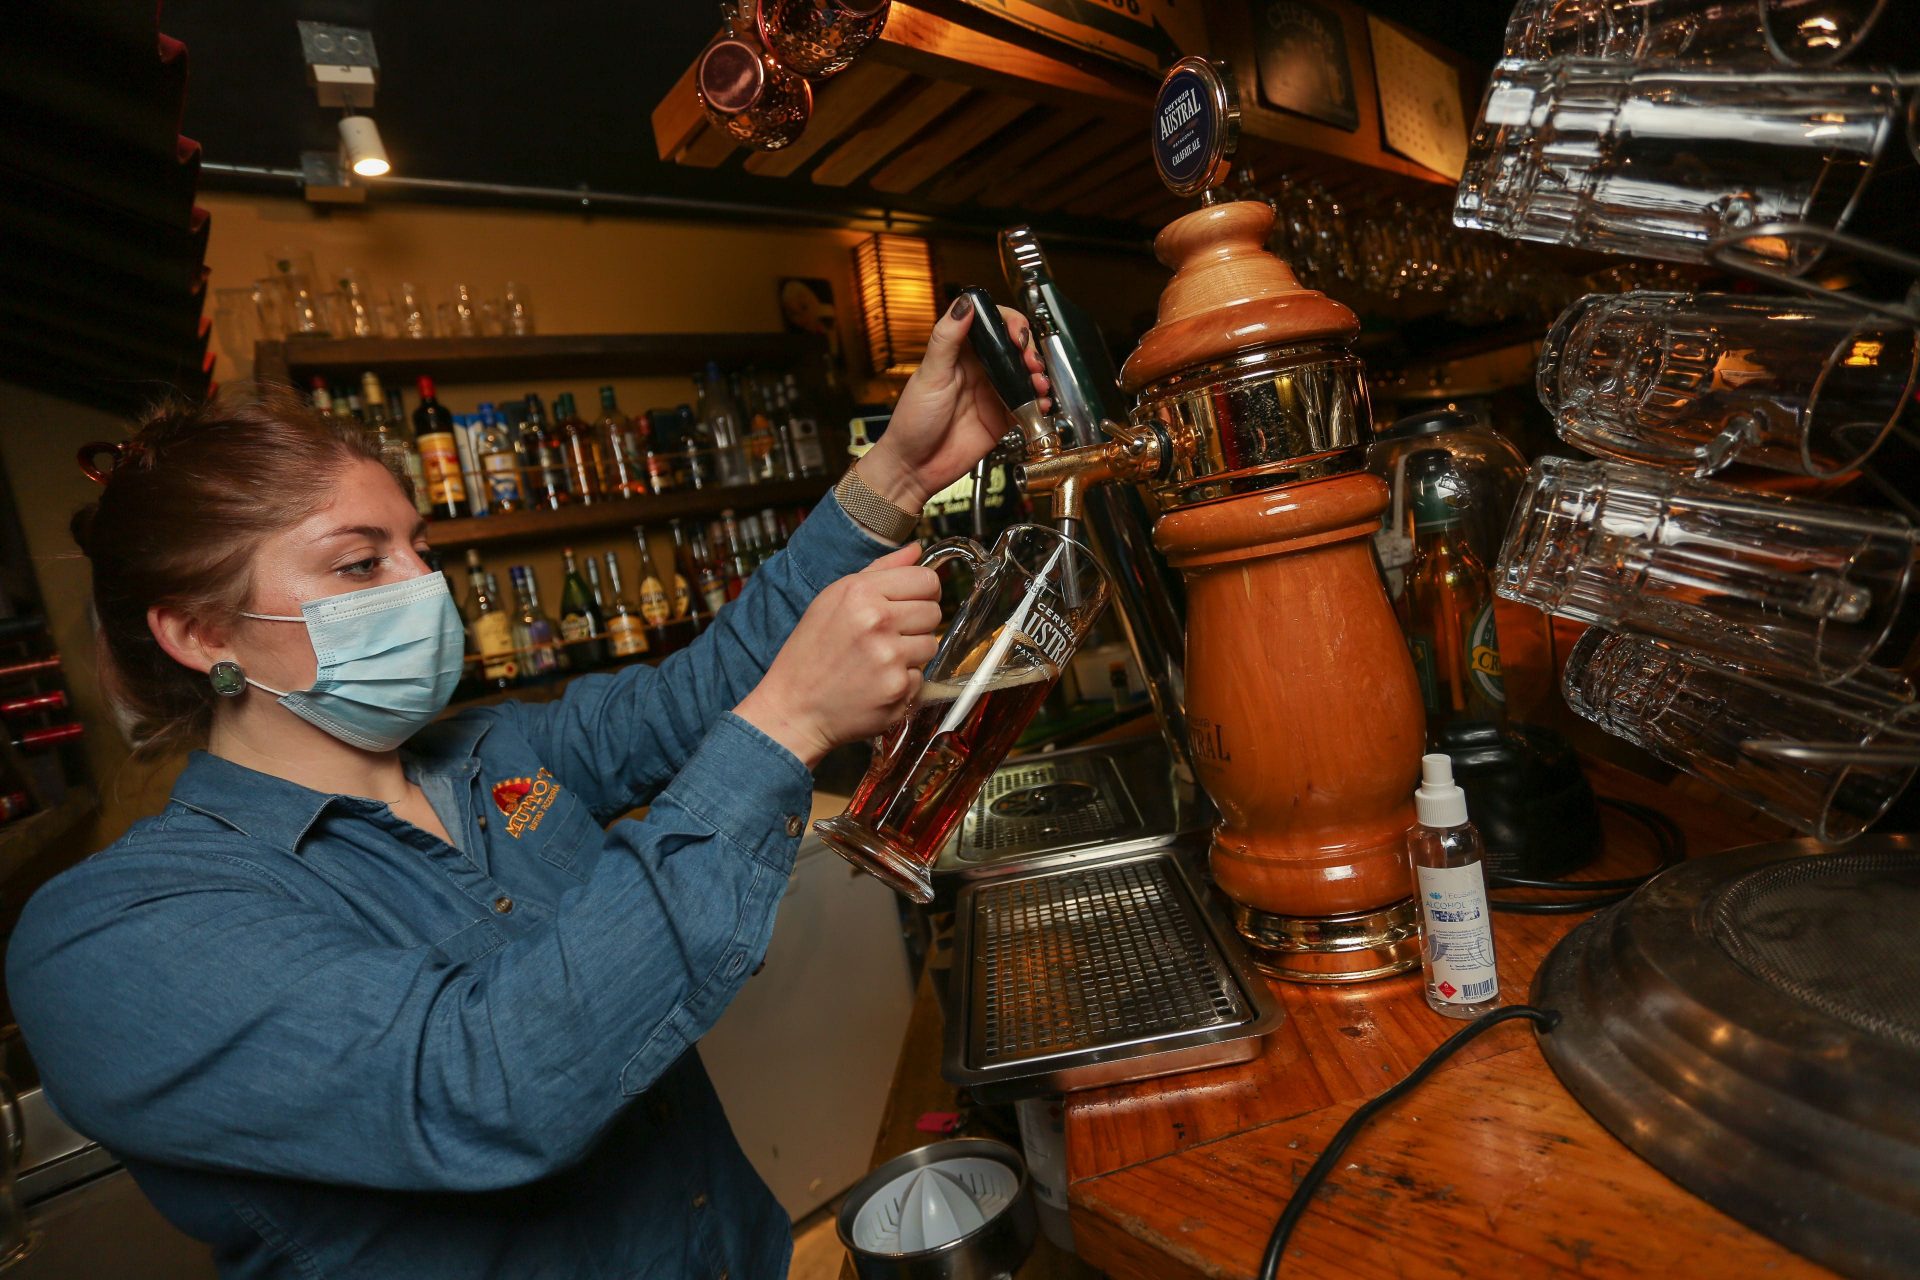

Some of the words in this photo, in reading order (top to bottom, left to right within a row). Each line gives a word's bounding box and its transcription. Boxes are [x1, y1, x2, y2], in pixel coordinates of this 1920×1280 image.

[1160, 88, 1201, 141] AUSTRAL
[1164, 89, 1190, 115] cerveza
[1171, 144, 1193, 166] CALAFATE
[1191, 137, 1202, 155] ALE
[1037, 602, 1077, 644] CERVEZA
[1425, 901, 1466, 910] ALCOHOL
